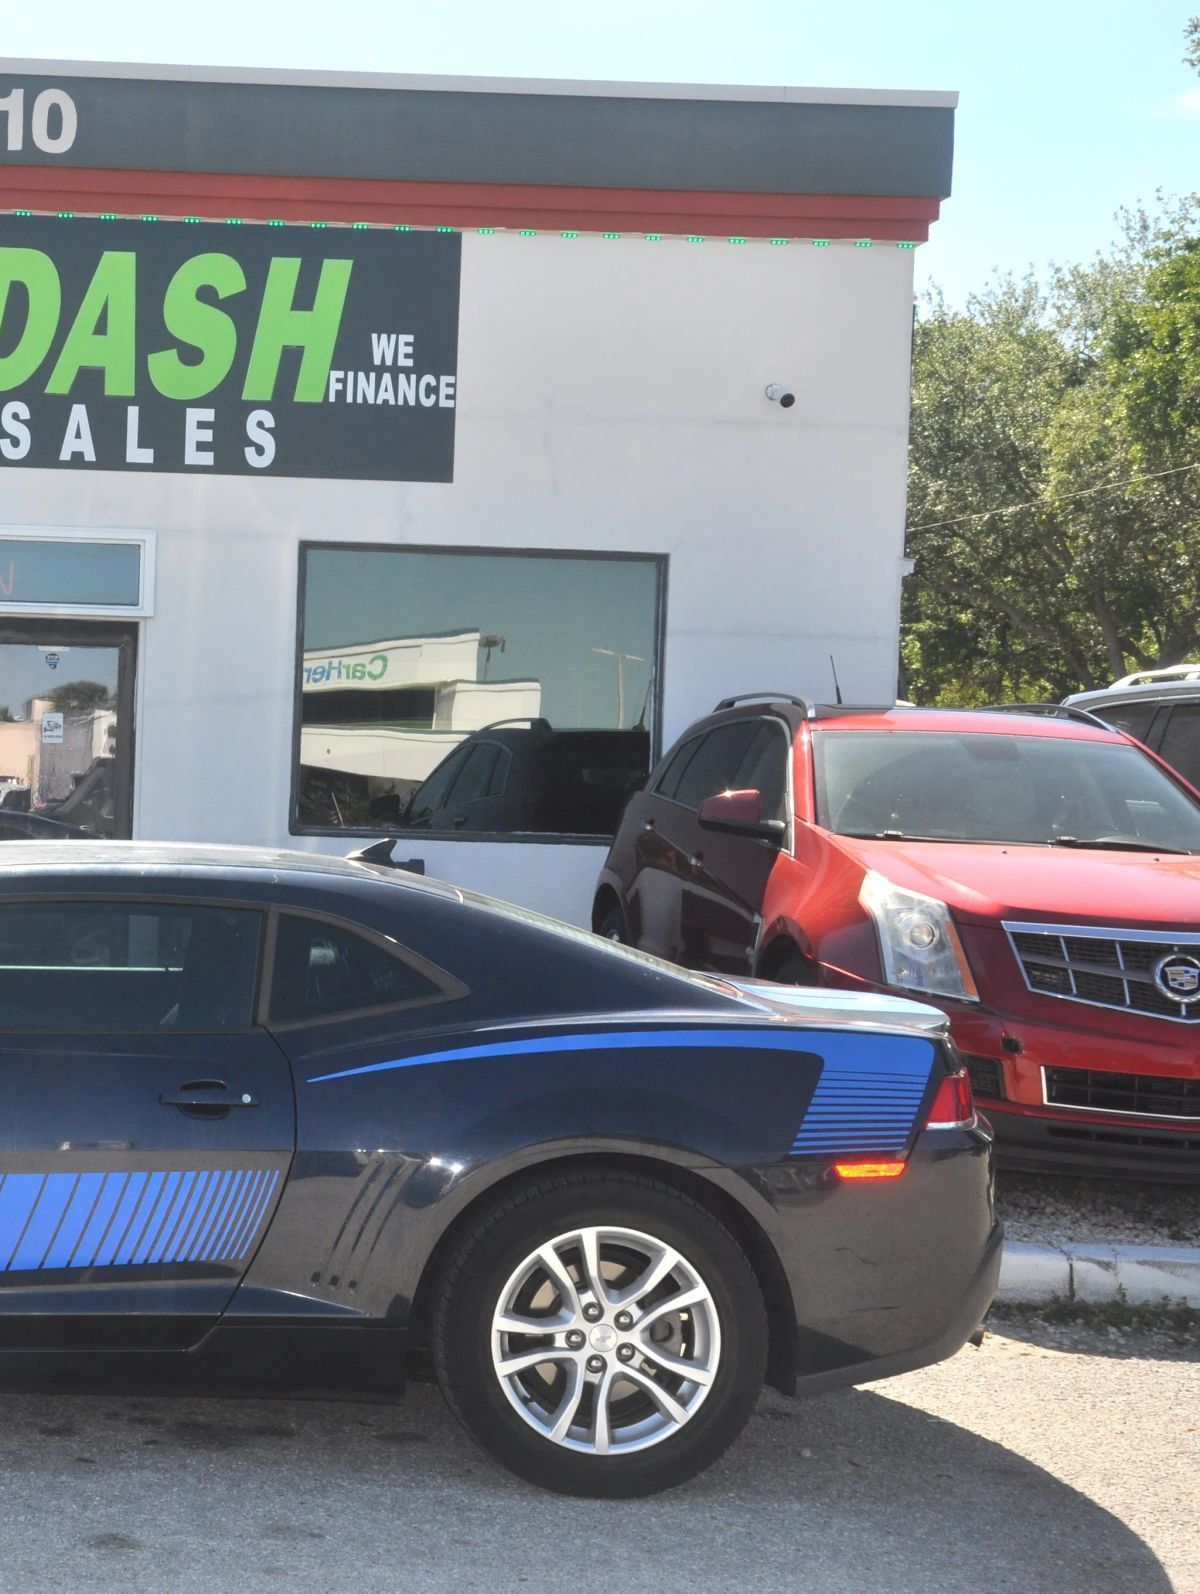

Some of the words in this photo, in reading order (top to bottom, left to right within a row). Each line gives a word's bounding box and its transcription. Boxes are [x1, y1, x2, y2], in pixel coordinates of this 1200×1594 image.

[371, 333, 414, 366] WE
[328, 370, 455, 408] FINANCE
[0, 401, 276, 468] SALES
